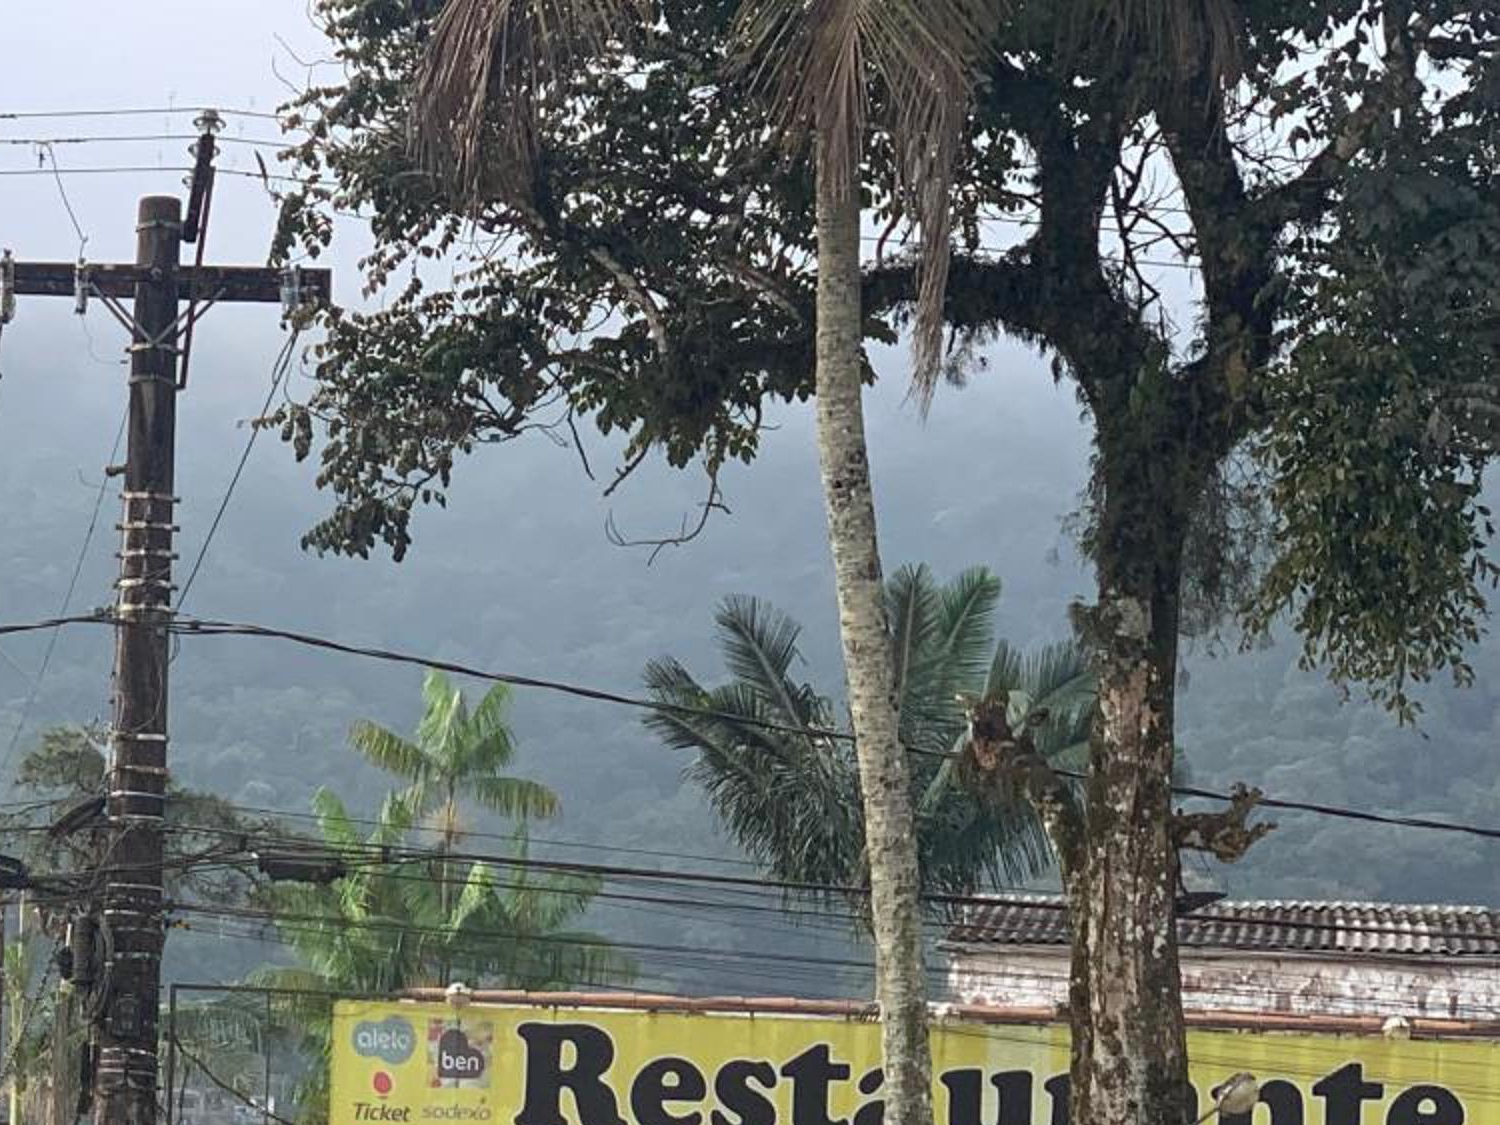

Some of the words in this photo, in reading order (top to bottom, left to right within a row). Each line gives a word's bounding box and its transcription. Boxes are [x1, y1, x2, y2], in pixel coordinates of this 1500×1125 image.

[357, 1029, 411, 1049] alelo
[441, 1052, 480, 1070] ben
[353, 1103, 411, 1122] Ticket
[421, 1103, 491, 1121] sodexo
